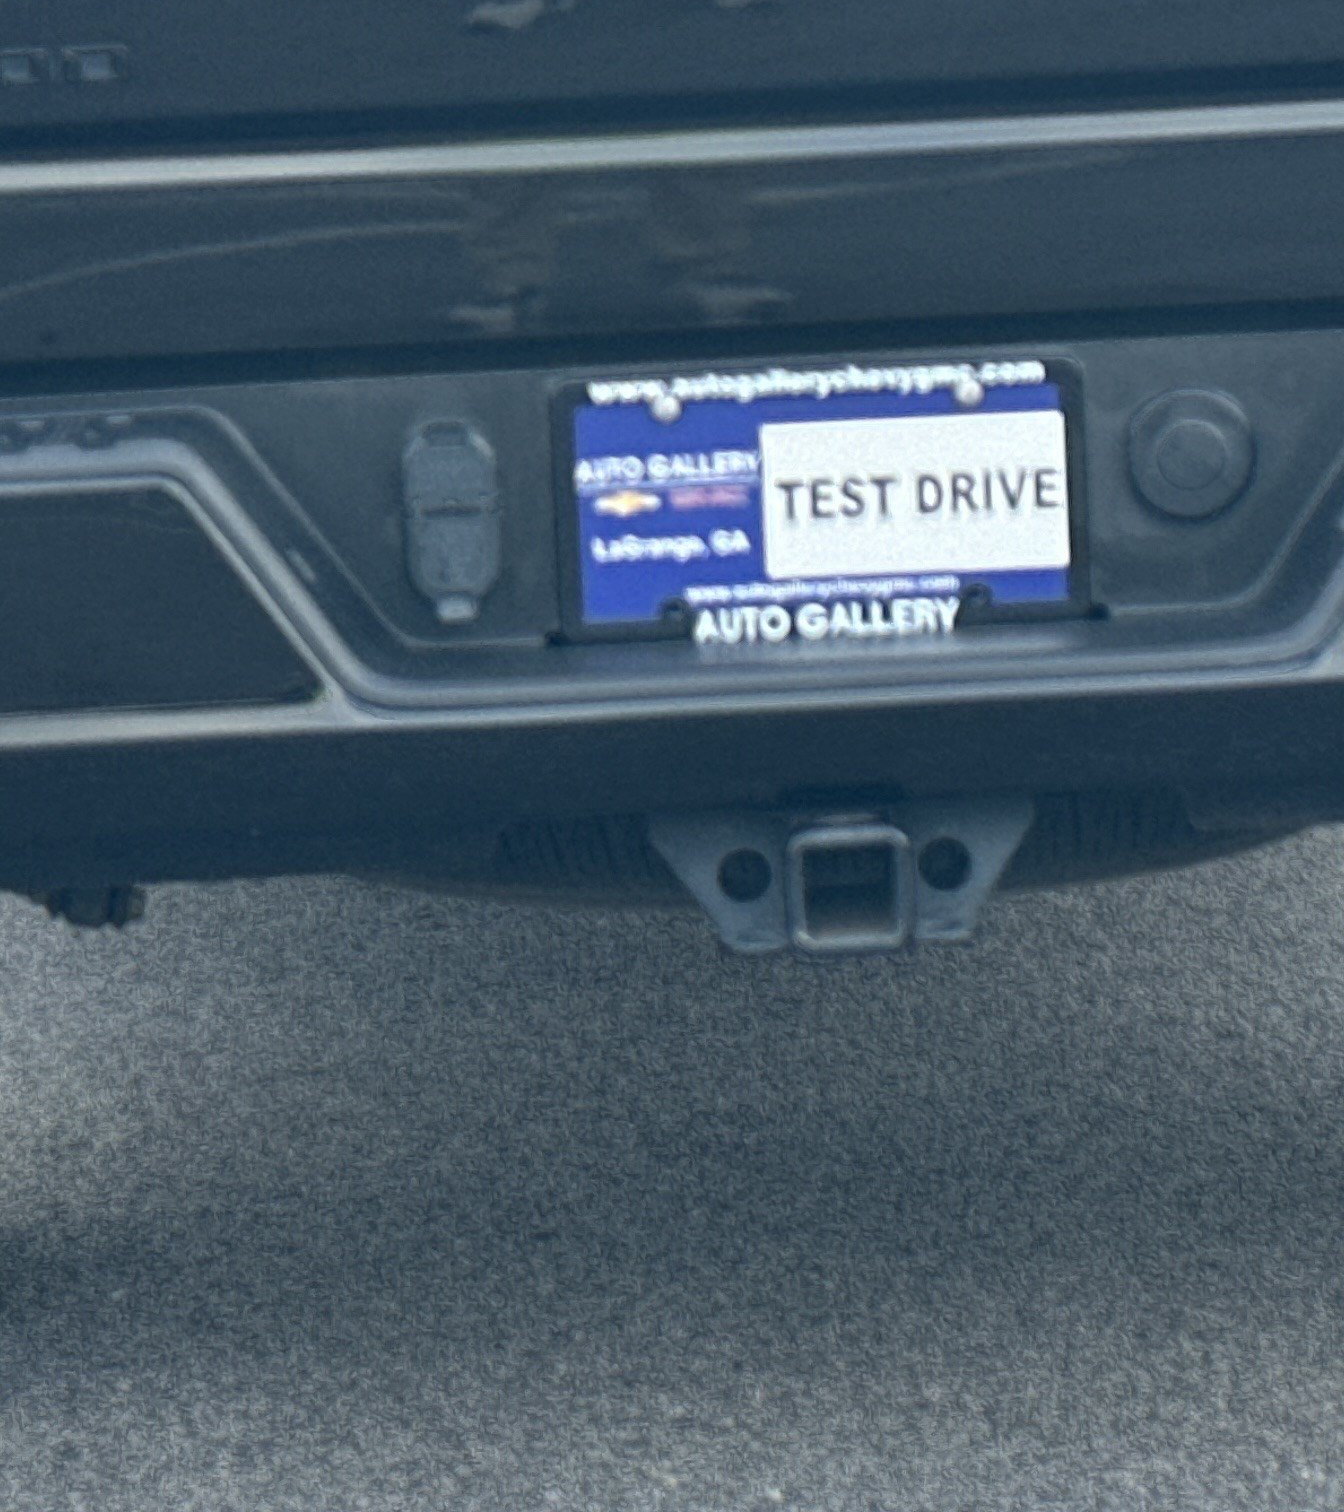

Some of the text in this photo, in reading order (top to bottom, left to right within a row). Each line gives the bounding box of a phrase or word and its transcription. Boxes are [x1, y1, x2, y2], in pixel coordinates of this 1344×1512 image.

[586, 360, 1045, 405] wwwautogallerychevygmccom
[574, 448, 760, 485] AUTO GALLERY
[777, 476, 897, 522] TEST
[916, 466, 1059, 515] DRIVE
[709, 528, 751, 557] GA
[695, 595, 960, 644] AUTO GALLERY
